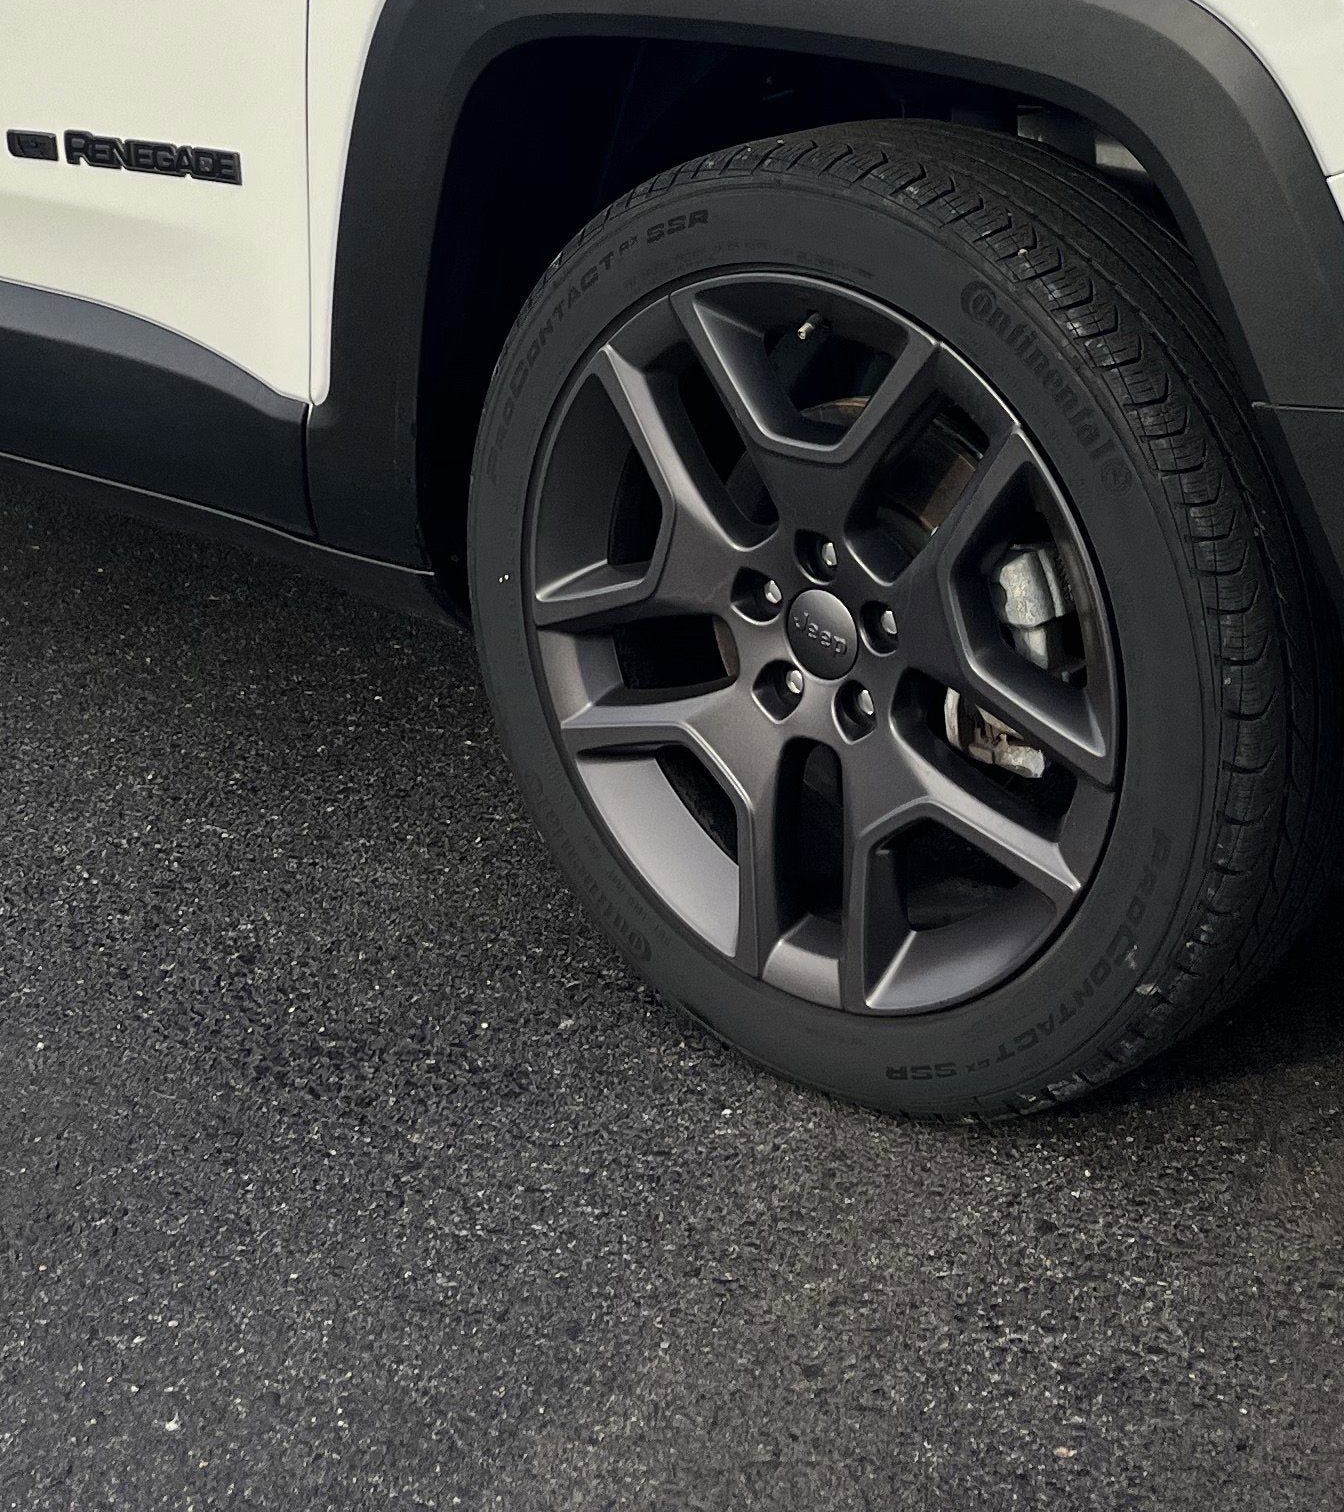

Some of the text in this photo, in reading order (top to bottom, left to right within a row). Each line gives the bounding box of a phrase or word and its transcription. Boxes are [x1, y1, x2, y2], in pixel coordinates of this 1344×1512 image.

[645, 208, 712, 245] SSR
[960, 279, 1116, 462] Continental
[793, 610, 848, 658] Jeep
[884, 1062, 959, 1081] SSR
